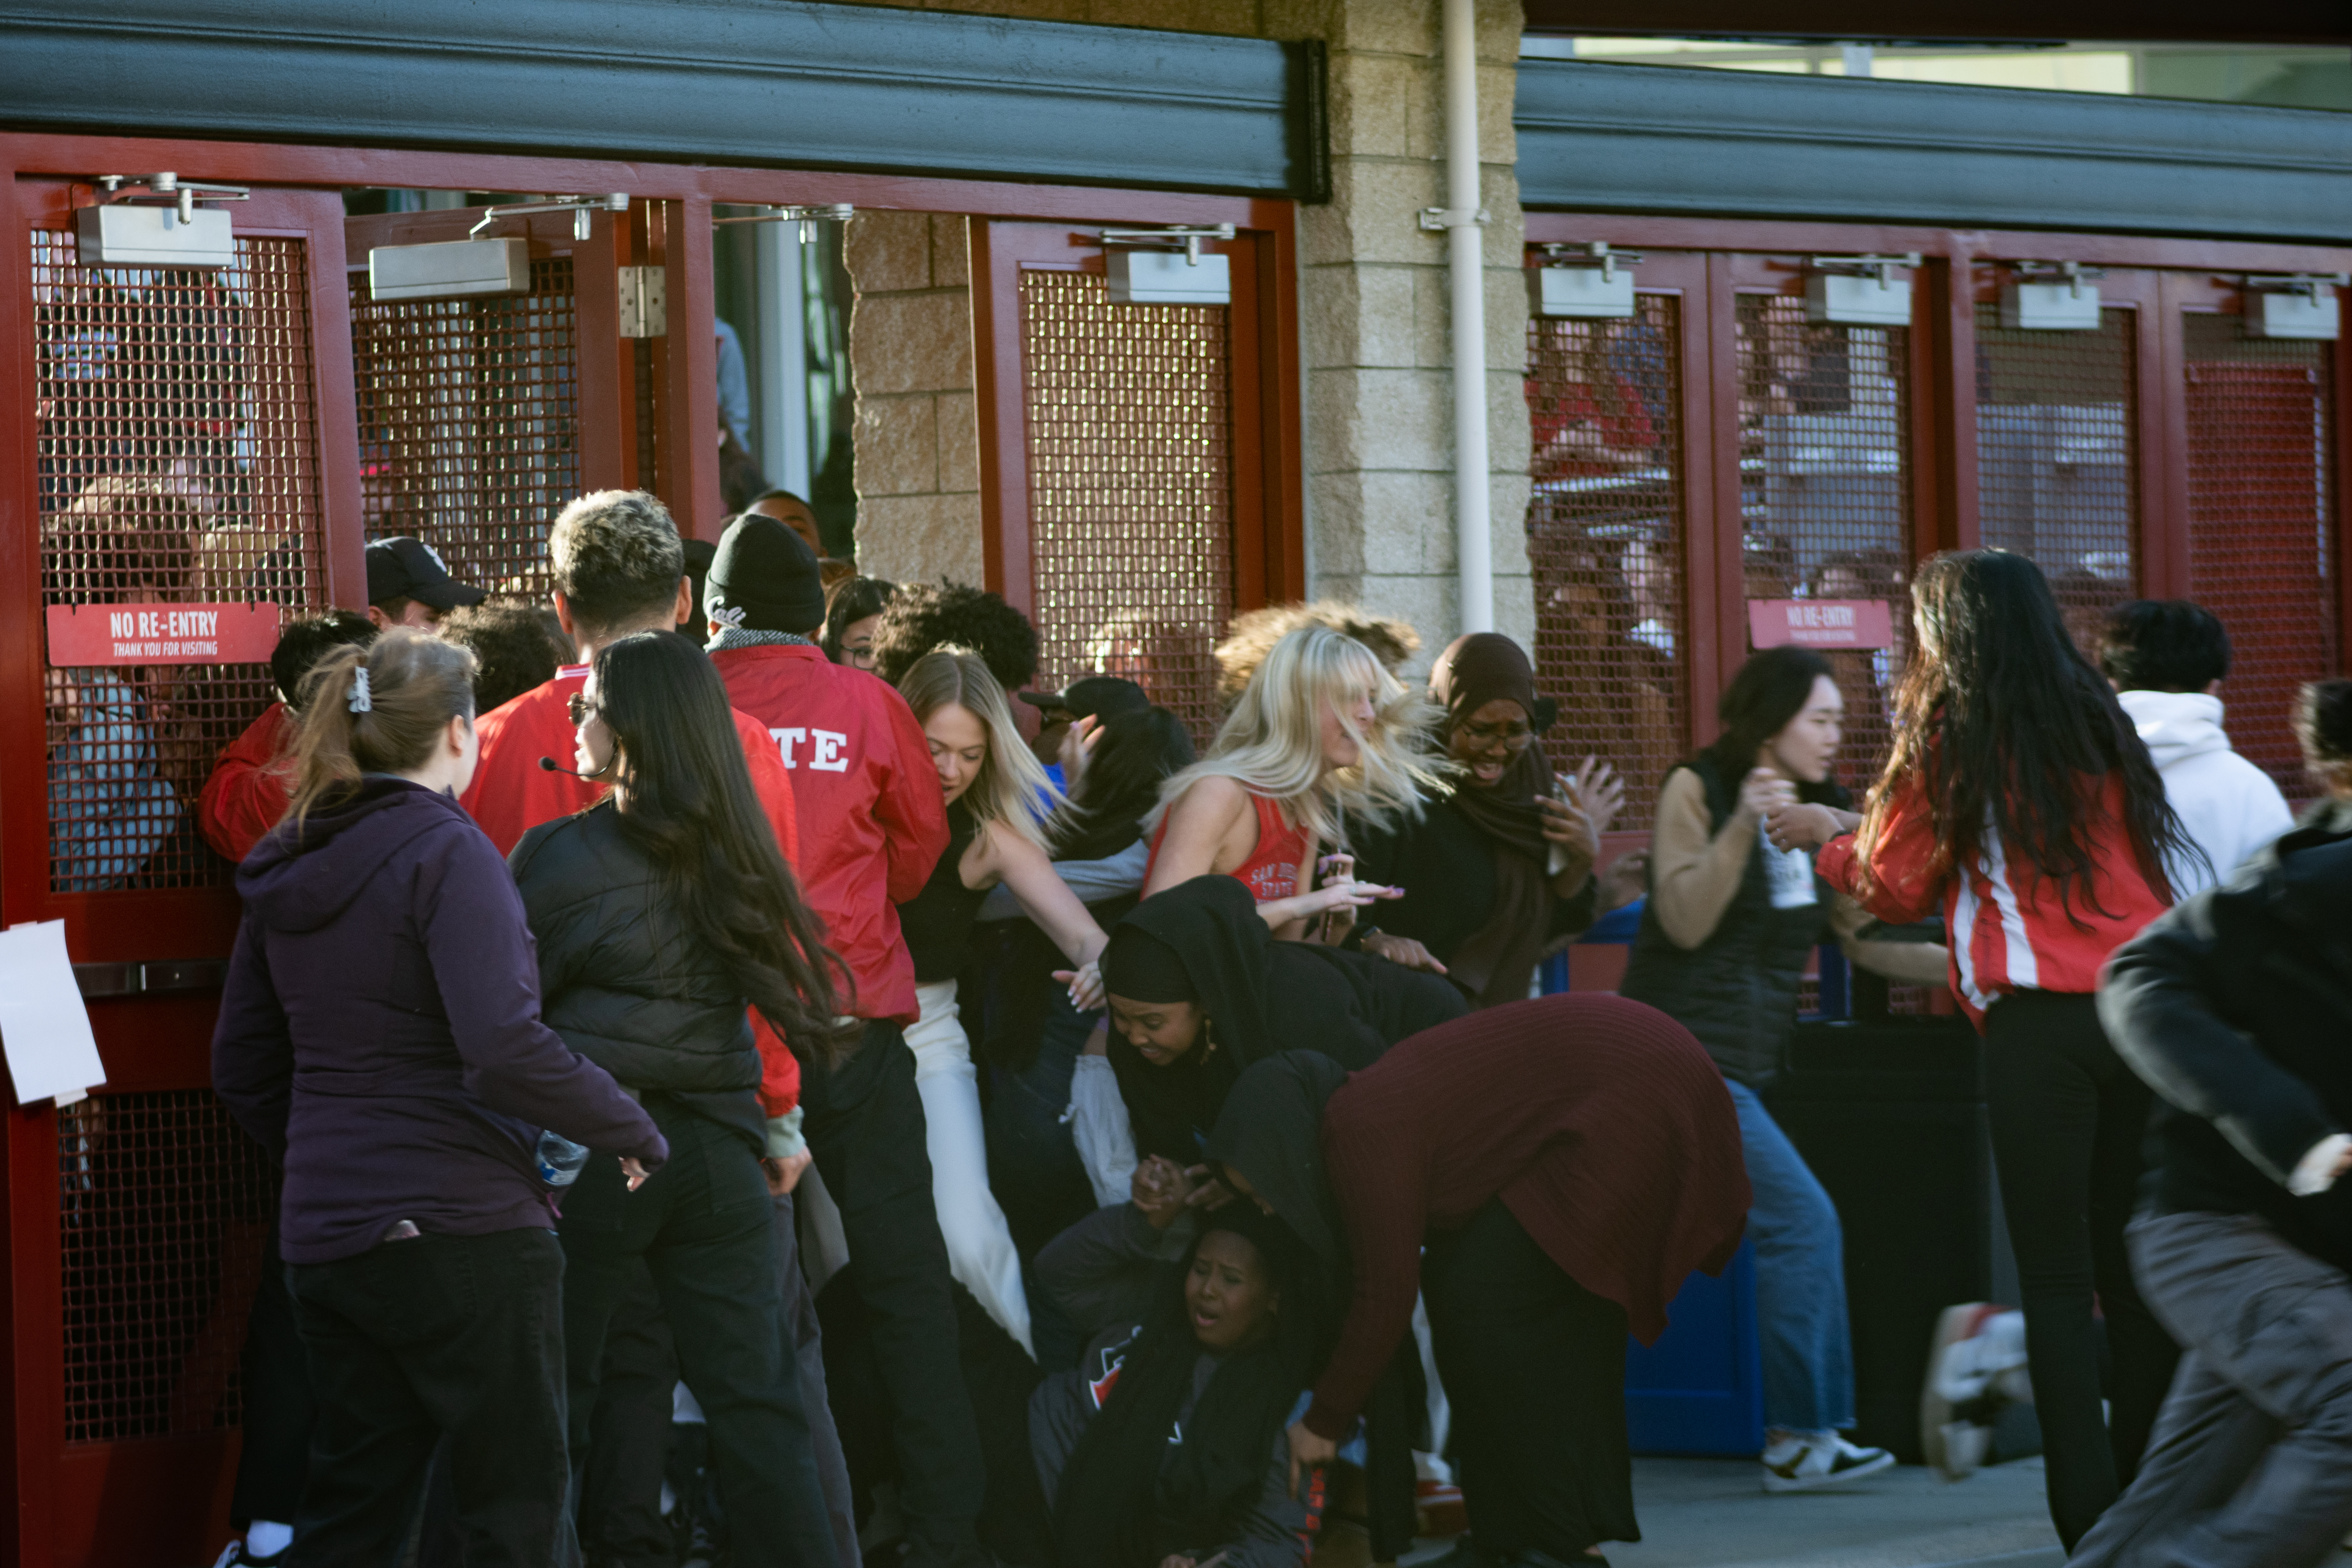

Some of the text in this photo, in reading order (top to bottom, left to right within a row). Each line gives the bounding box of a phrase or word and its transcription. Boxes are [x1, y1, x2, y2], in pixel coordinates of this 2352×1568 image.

[111, 611, 218, 638] NO RE-ENTRY
[706, 596, 746, 628] Cali
[114, 641, 218, 657] THANK YOU FOR VISITING
